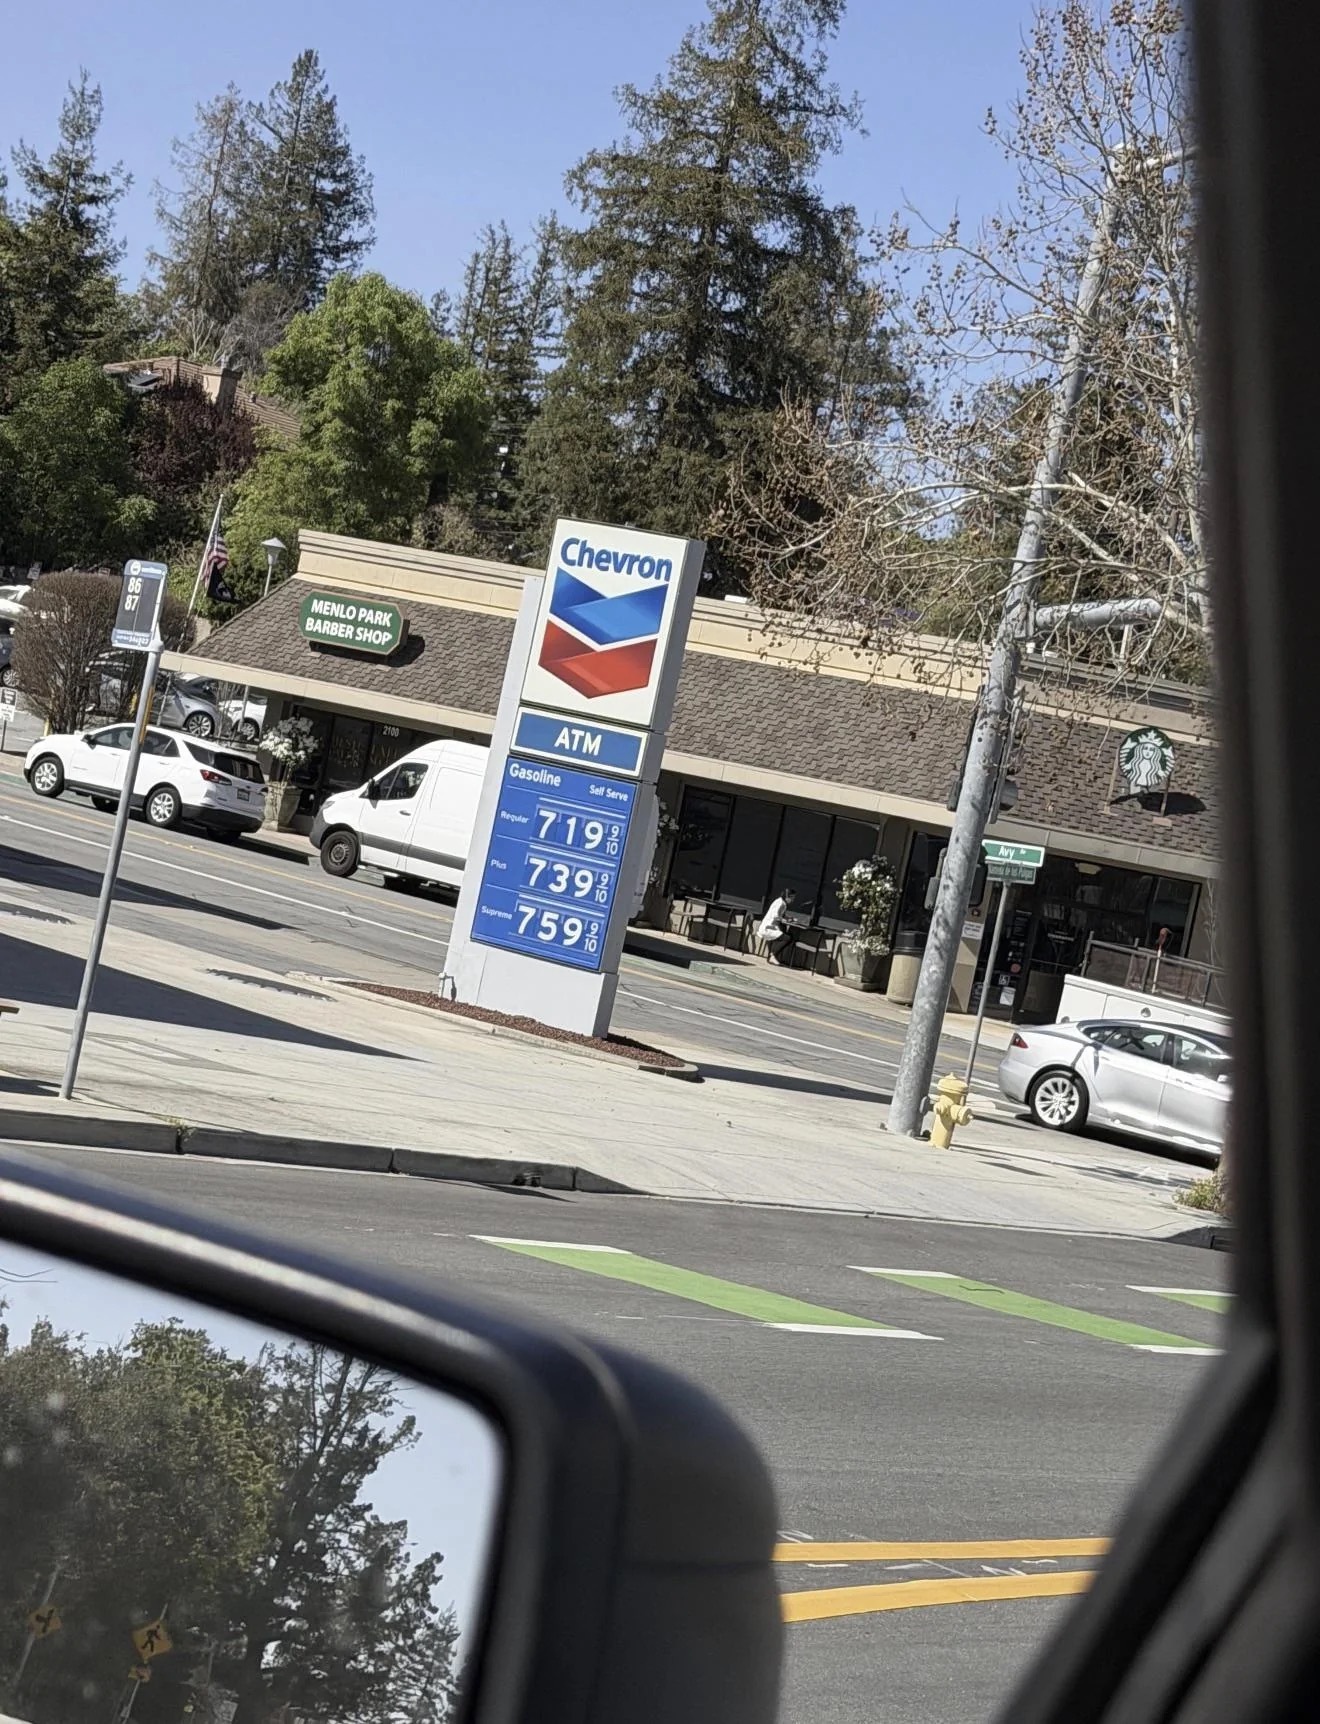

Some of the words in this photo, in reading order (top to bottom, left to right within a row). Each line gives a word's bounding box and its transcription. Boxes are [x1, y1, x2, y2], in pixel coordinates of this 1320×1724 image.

[560, 537, 673, 582] Chevron
[127, 576, 143, 594] 86
[124, 594, 140, 612] 87
[310, 598, 357, 620] MENLO
[357, 607, 393, 628] PARK
[305, 616, 354, 640] BARBER
[355, 626, 393, 646] SHOP
[554, 726, 602, 757] ATM
[509, 763, 562, 787] Gasoline
[589, 784, 605, 797] Self
[606, 788, 629, 802] Serve
[500, 810, 529, 824] Regular
[538, 809, 604, 850] 719
[490, 859, 507, 870] Plus
[998, 845, 1016, 860] Avy
[528, 857, 594, 898] 739
[481, 905, 513, 920] Supreme
[518, 905, 583, 946] 759
